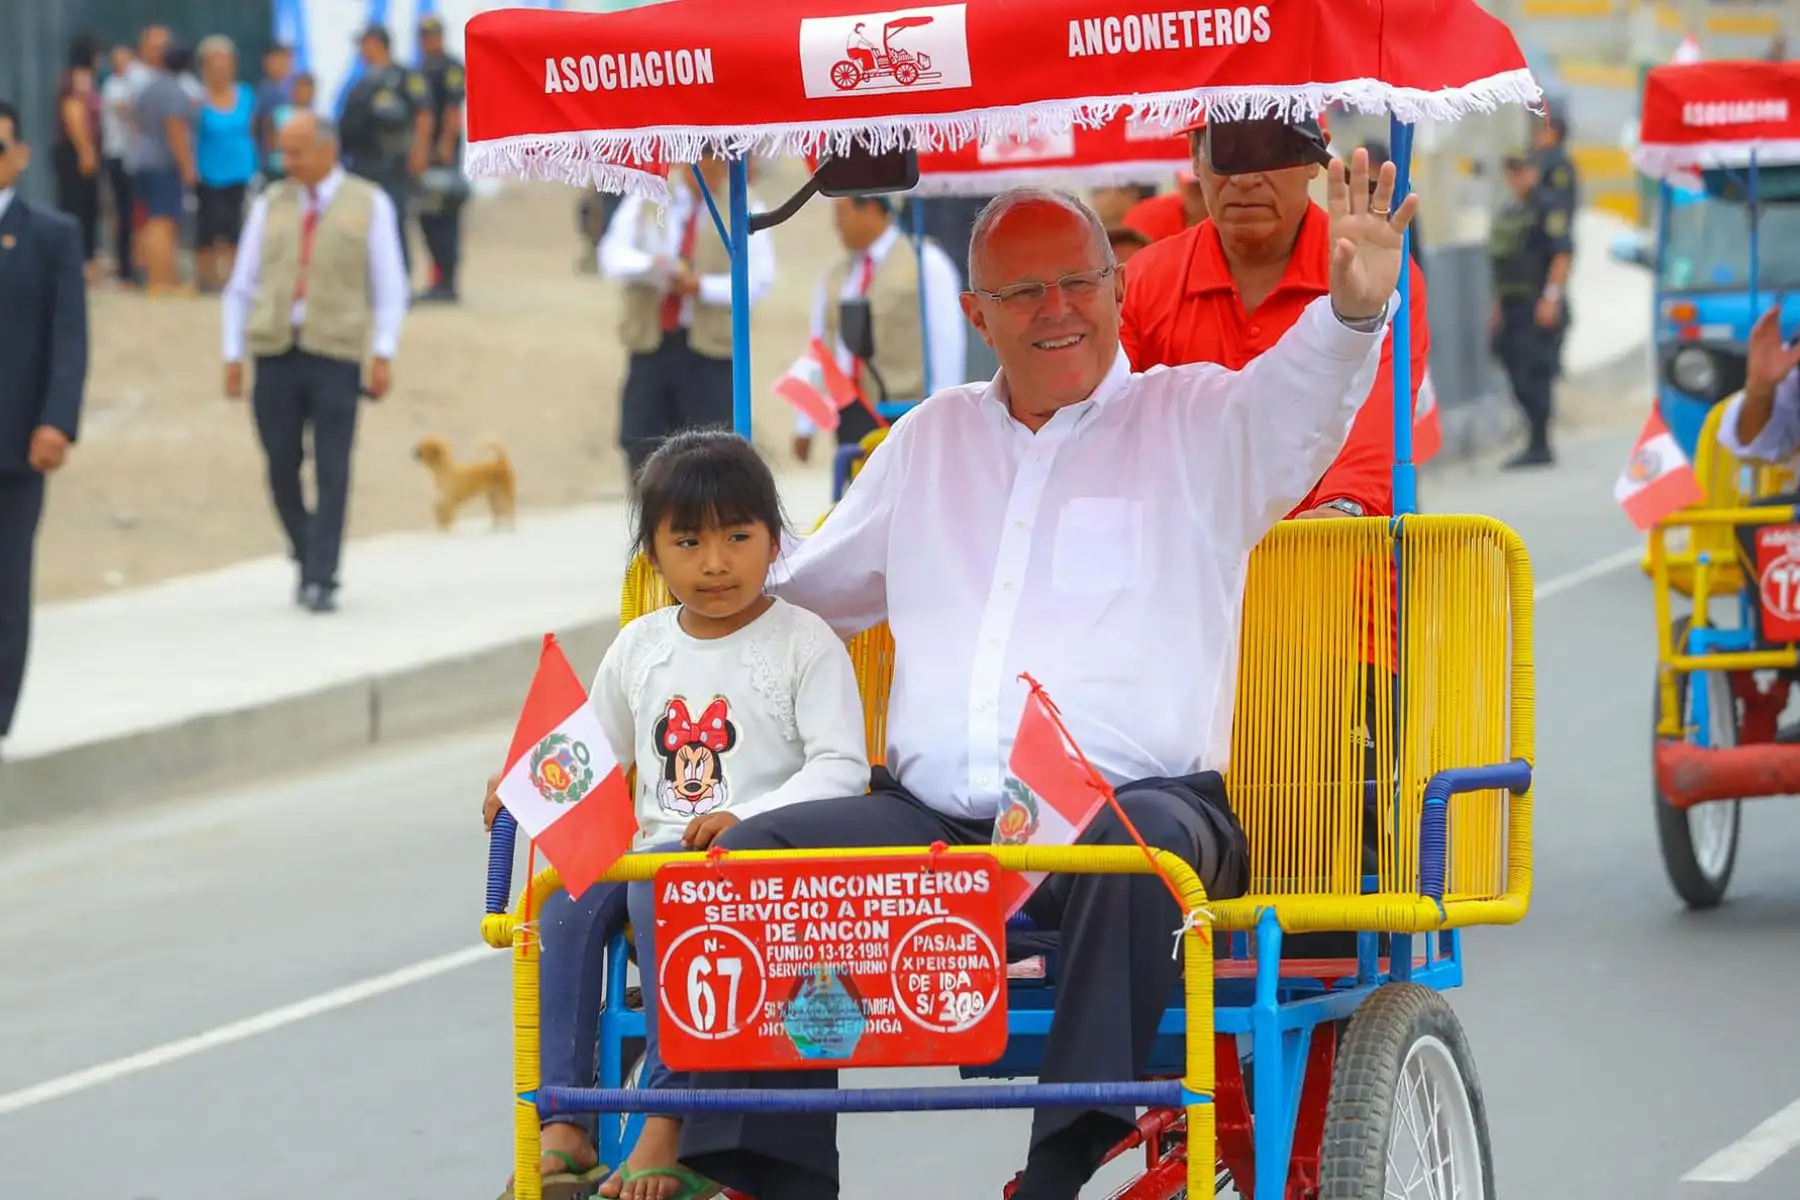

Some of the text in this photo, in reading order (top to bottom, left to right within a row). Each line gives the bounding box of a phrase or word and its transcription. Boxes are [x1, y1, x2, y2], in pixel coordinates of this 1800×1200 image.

[545, 5, 1271, 94] ASOCIACION ANCONETEROS
[662, 869, 990, 904] ASOC. DE ANCONETEROS
[704, 897, 949, 923] SERVICIO A PEDAL
[765, 919, 889, 943] DE ANCON
[913, 933, 977, 952] PASAJE
[766, 944, 814, 961] FUNDO
[916, 954, 990, 971] PERSONA
[823, 960, 888, 976] NOCTURNO
[908, 970, 972, 992] DE IDA
[687, 955, 743, 1031] 67
